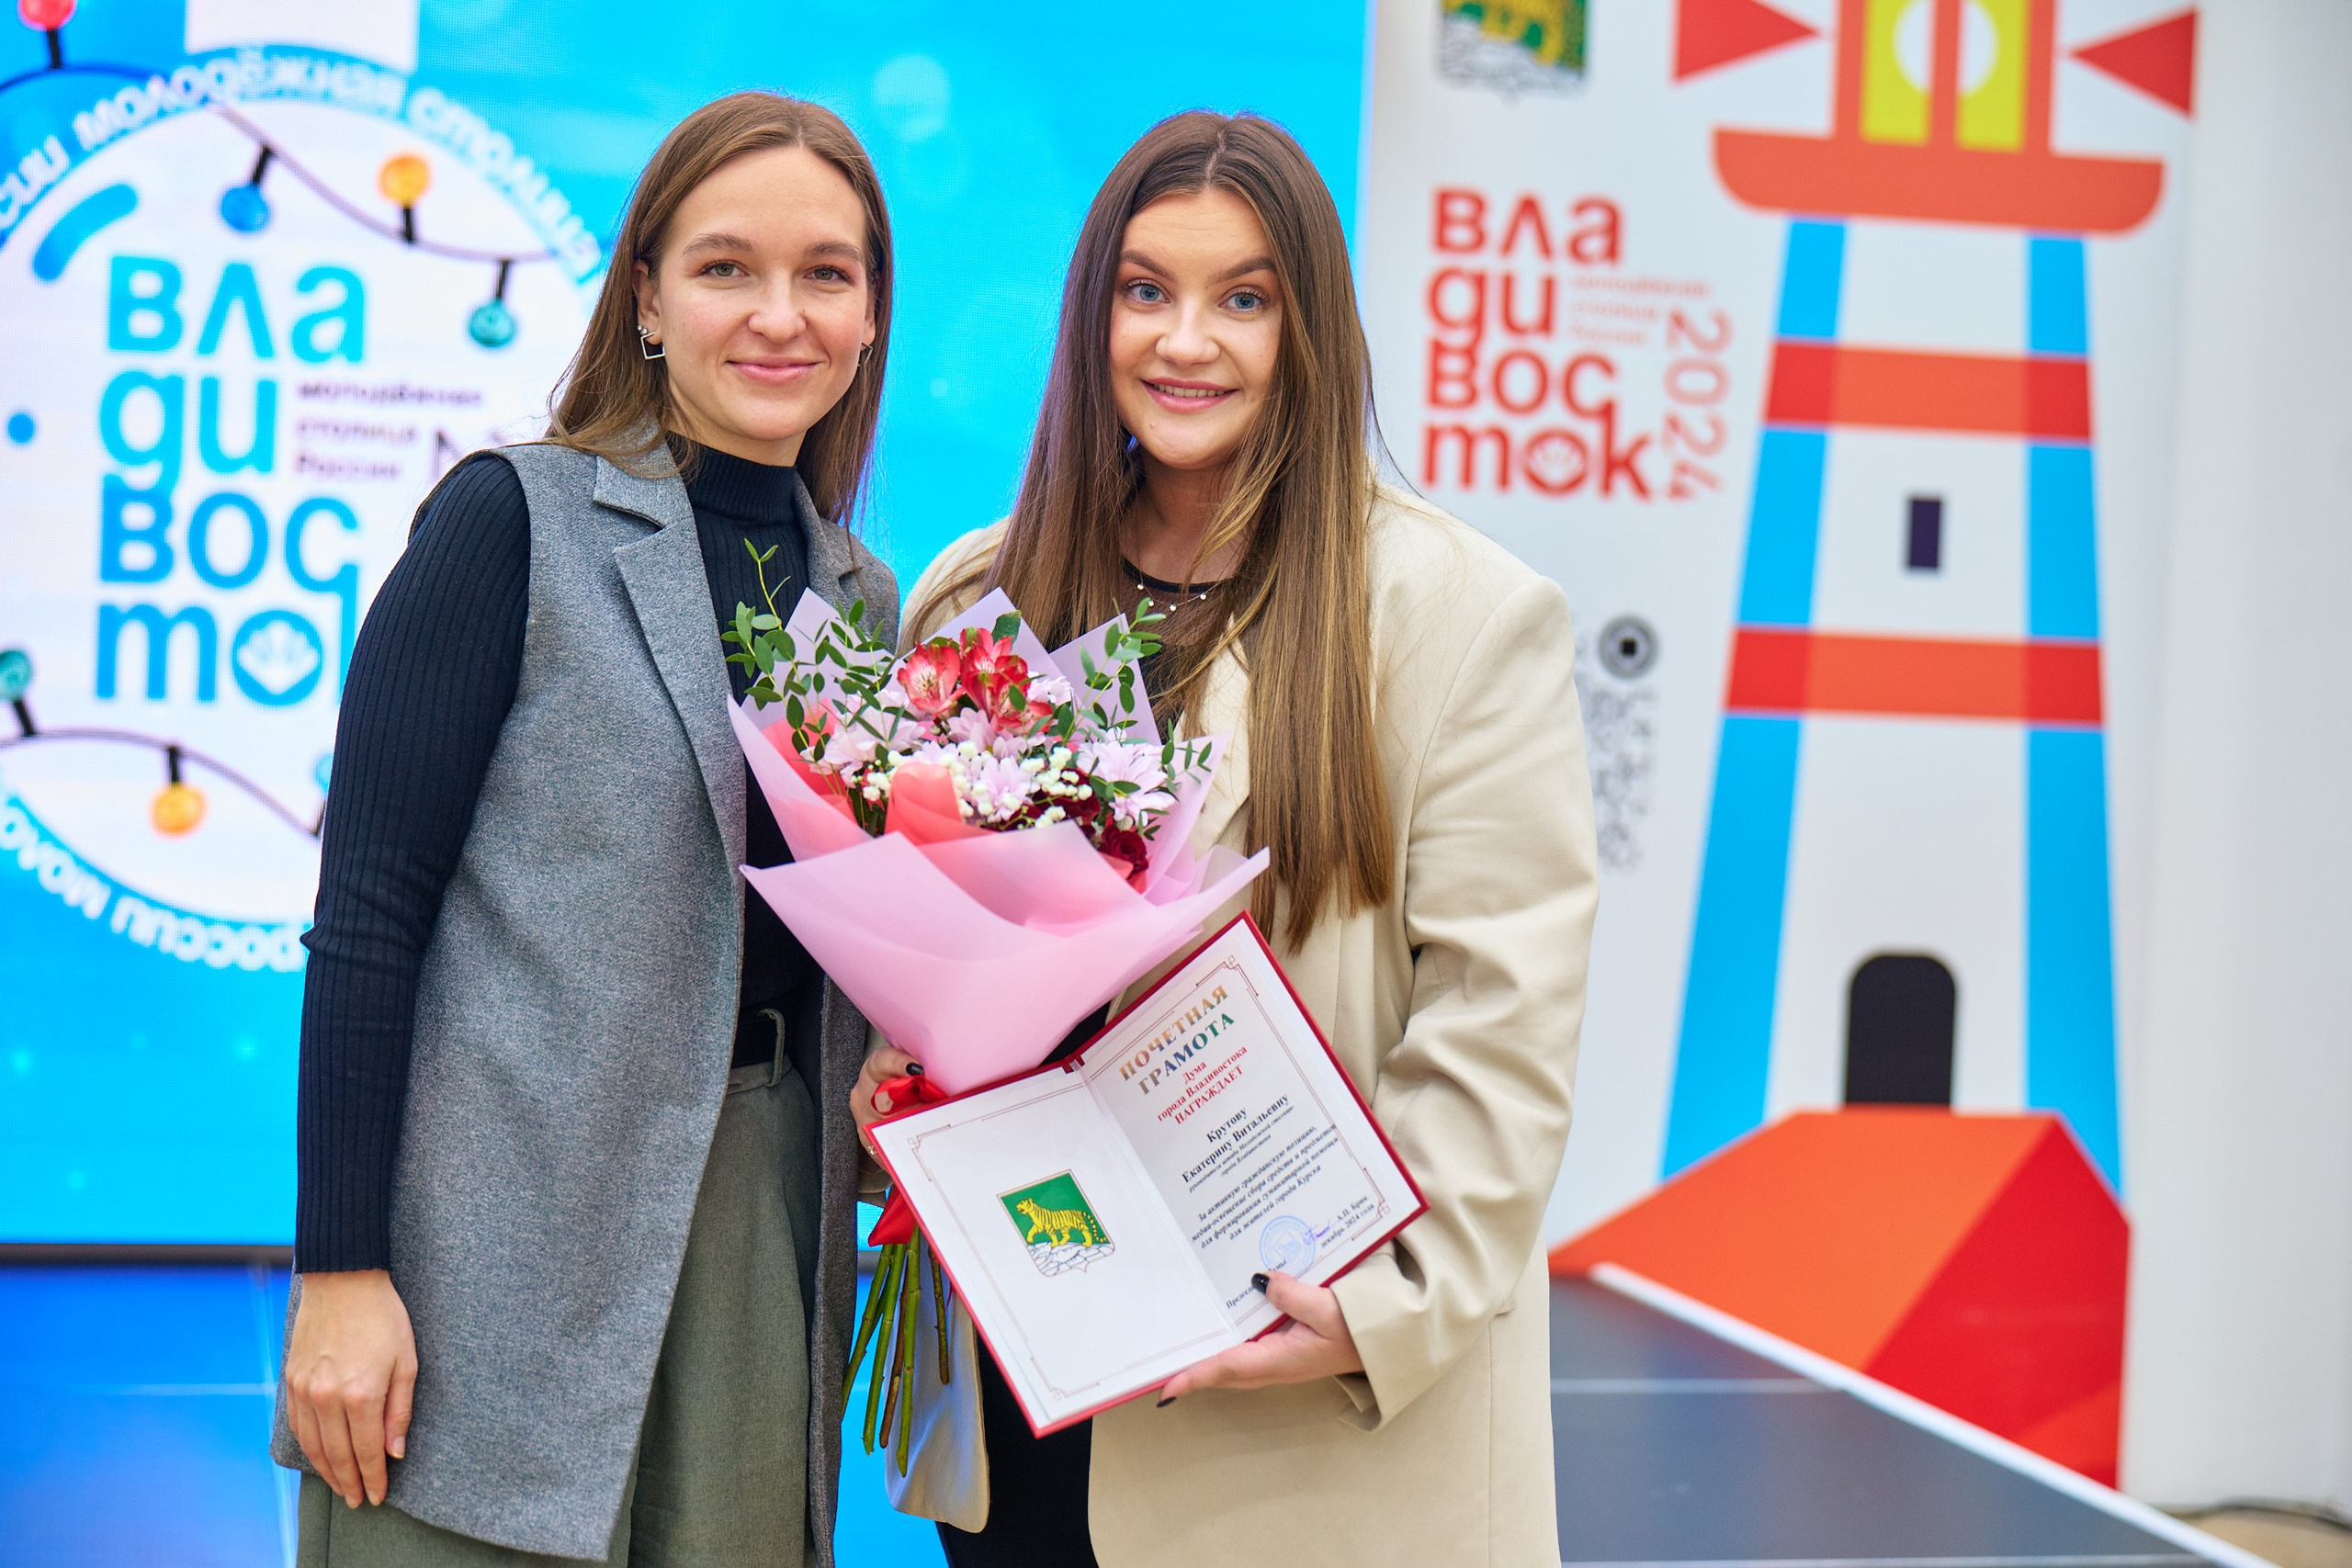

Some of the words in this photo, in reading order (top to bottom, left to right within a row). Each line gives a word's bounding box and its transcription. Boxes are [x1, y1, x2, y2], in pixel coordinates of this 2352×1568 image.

[1117, 984, 1228, 1081] ПОЧЕТНАЯ
[1137, 1012, 1235, 1095] ГРАМОТА
[1156, 1094, 1187, 1122] города
[1184, 1045, 1248, 1098] Владивостока
[1173, 1065, 1242, 1124] НАГРАЖДАЕТ
[1182, 1061, 1207, 1086] Дума
[1181, 1140, 1232, 1183] Екатерину
[1231, 1095, 1288, 1143] Витальевну
[1205, 1109, 1247, 1144] Крутову
[1191, 1194, 1247, 1243] медиа-освещение
[1246, 1178, 1267, 1198] сбора
[1265, 1156, 1294, 1182] средств
[1197, 1212, 1207, 1222] За
[1206, 1185, 1240, 1215] активную
[1240, 1148, 1285, 1189] гражданскую
[1200, 1235, 1214, 1249] для
[1212, 1197, 1261, 1240] формирования
[1261, 1157, 1311, 1201] гуманитарной
[1309, 1135, 1339, 1161] помощи
[1228, 1226, 1242, 1240] для
[1241, 1201, 1274, 1231] жителей
[1274, 1183, 1297, 1205] города
[1295, 1164, 1321, 1187] Курска
